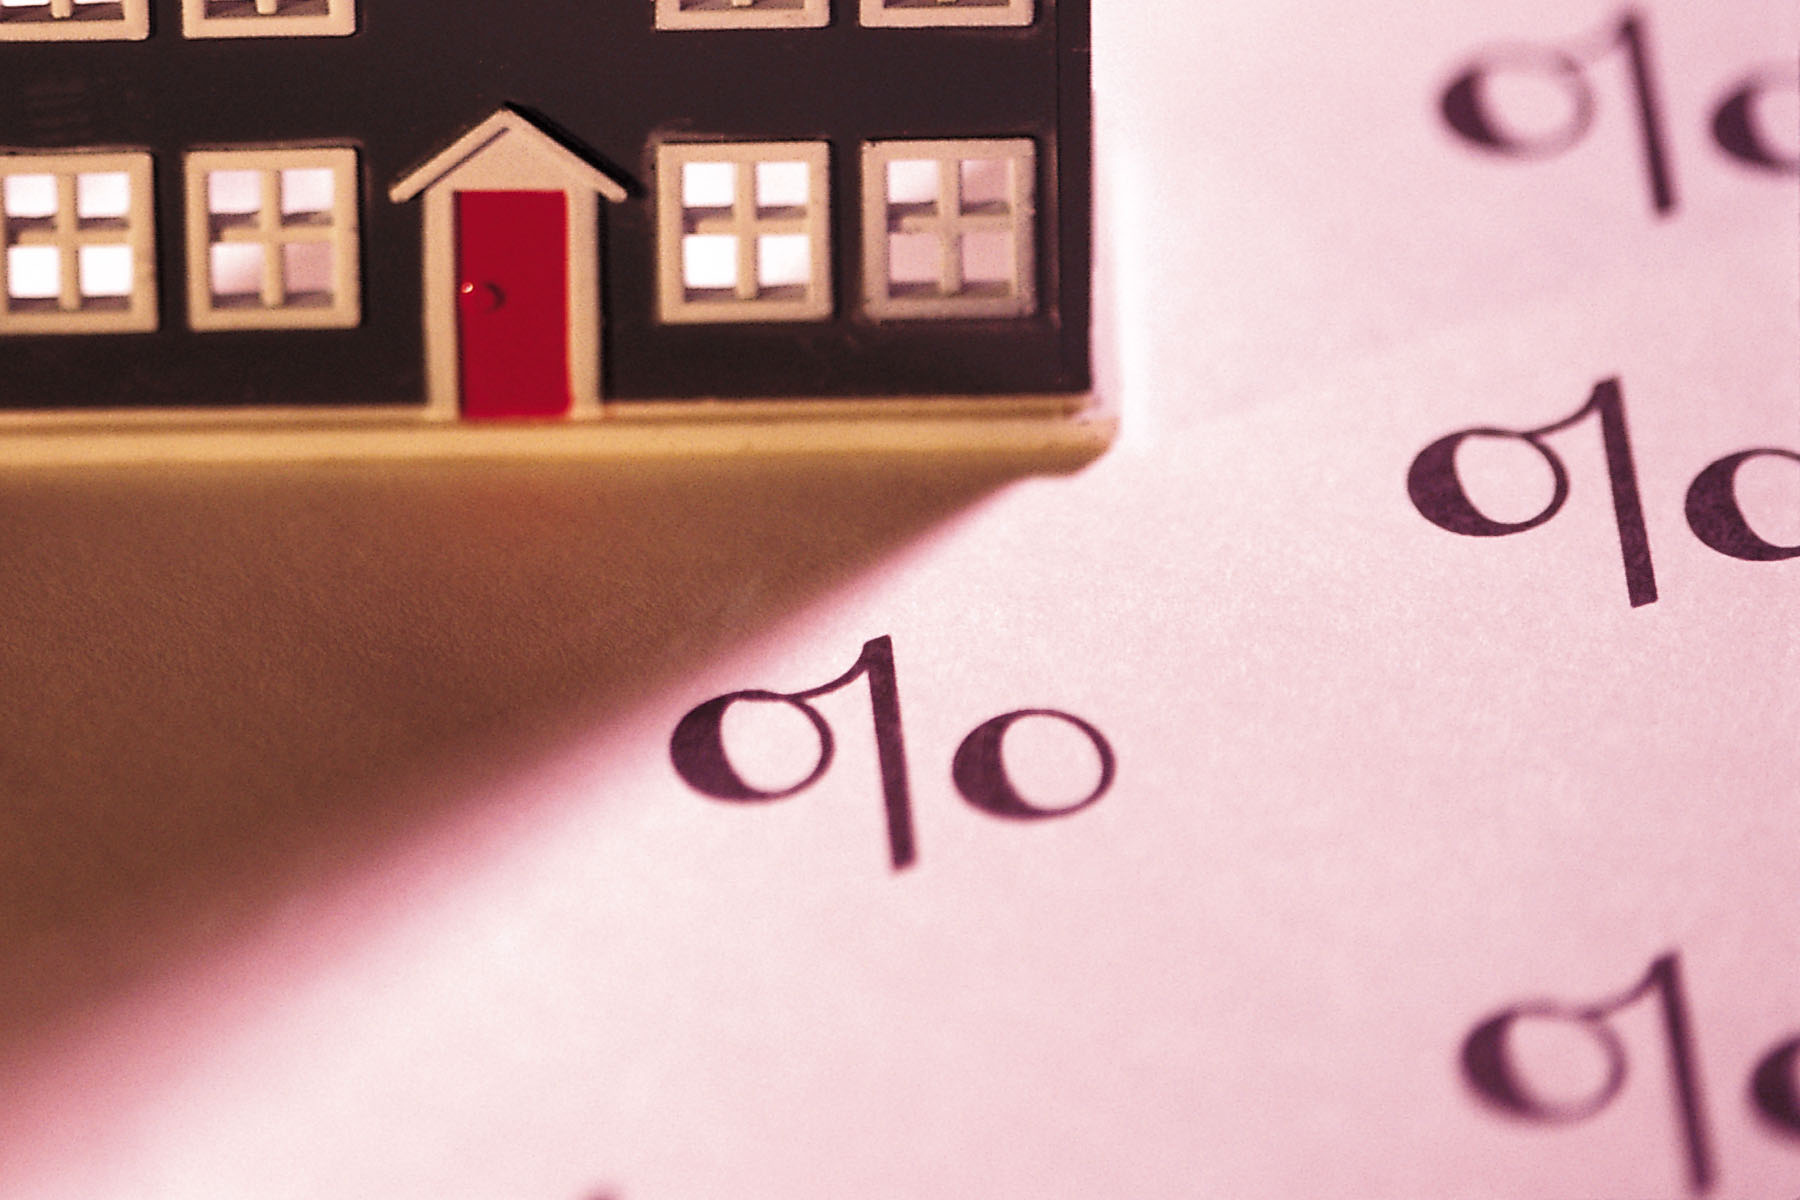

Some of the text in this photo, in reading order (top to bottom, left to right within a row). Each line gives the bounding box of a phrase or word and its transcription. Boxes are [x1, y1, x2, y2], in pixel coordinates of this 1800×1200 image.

[1436, 3, 1800, 219] %
[1407, 376, 1800, 608] %
[670, 635, 1116, 873] %
[1460, 950, 1800, 1200] %
